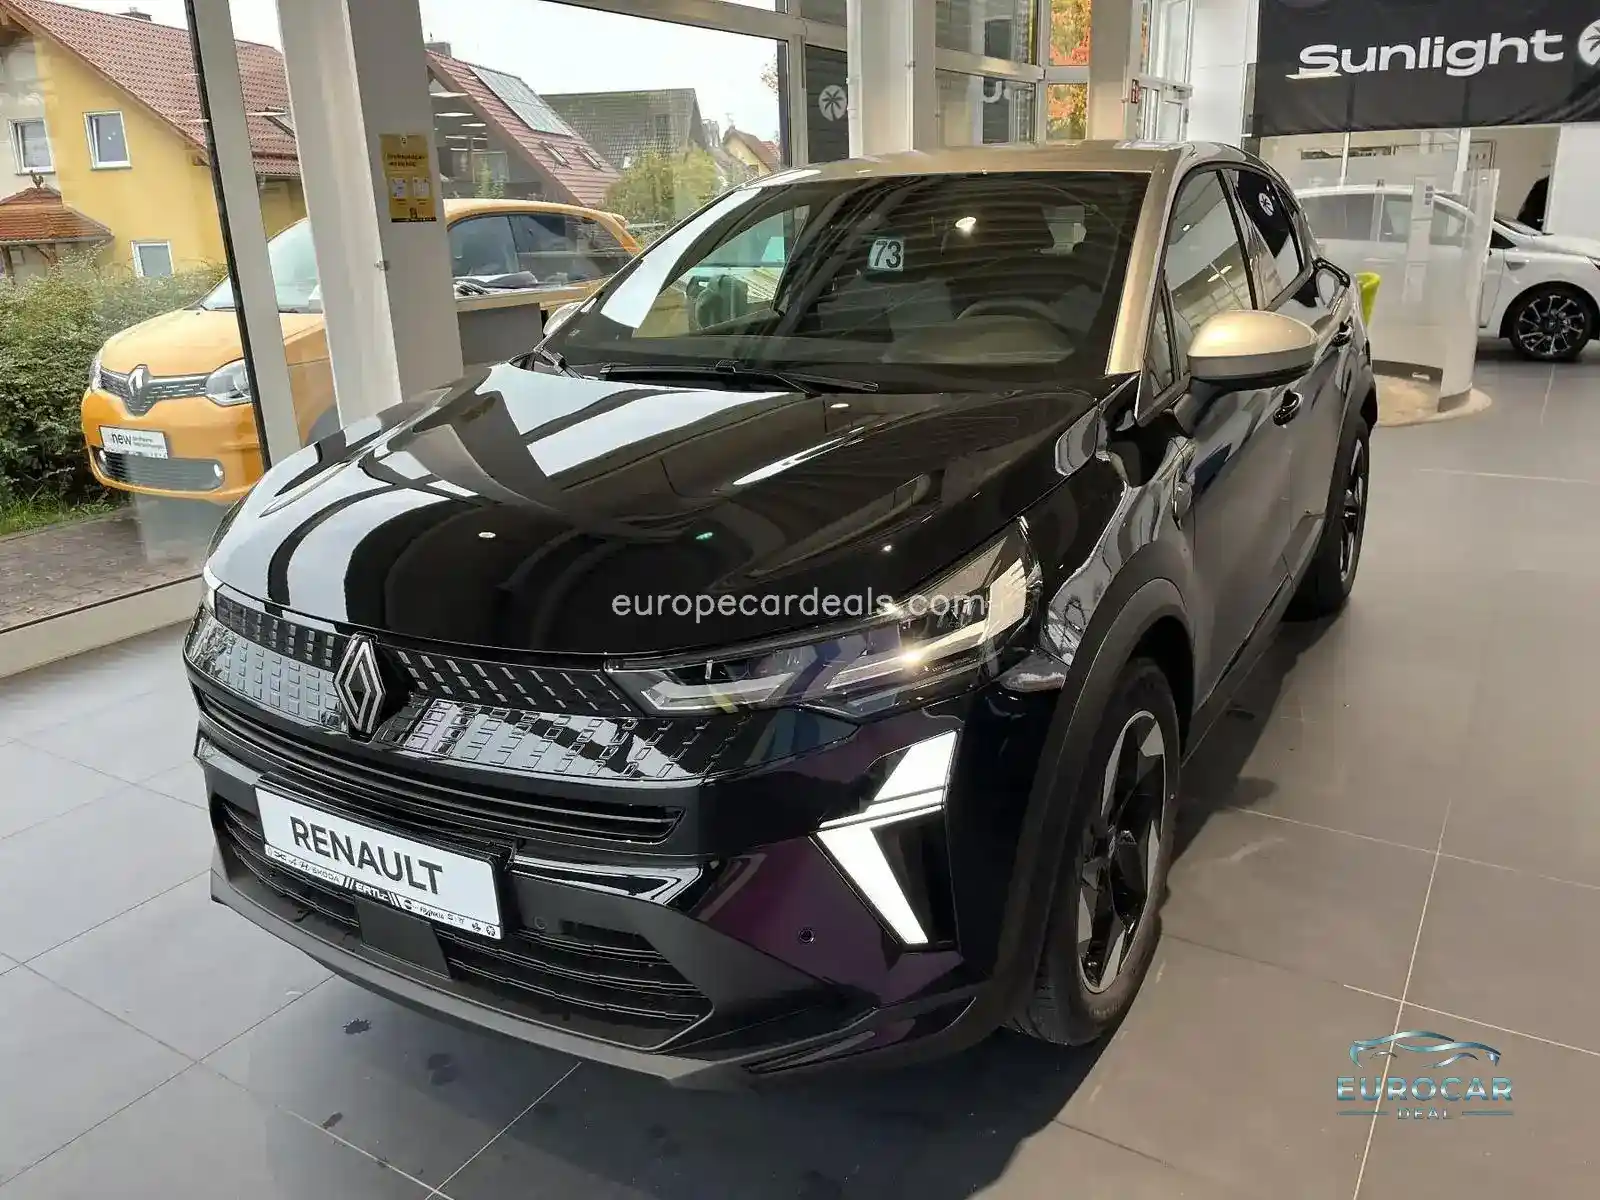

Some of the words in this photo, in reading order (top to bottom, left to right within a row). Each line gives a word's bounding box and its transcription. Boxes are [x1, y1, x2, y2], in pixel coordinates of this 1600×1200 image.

[1298, 29, 1564, 77] Sunlight
[874, 240, 901, 268] 73
[111, 432, 132, 446] new
[290, 815, 443, 895] RENAULT
